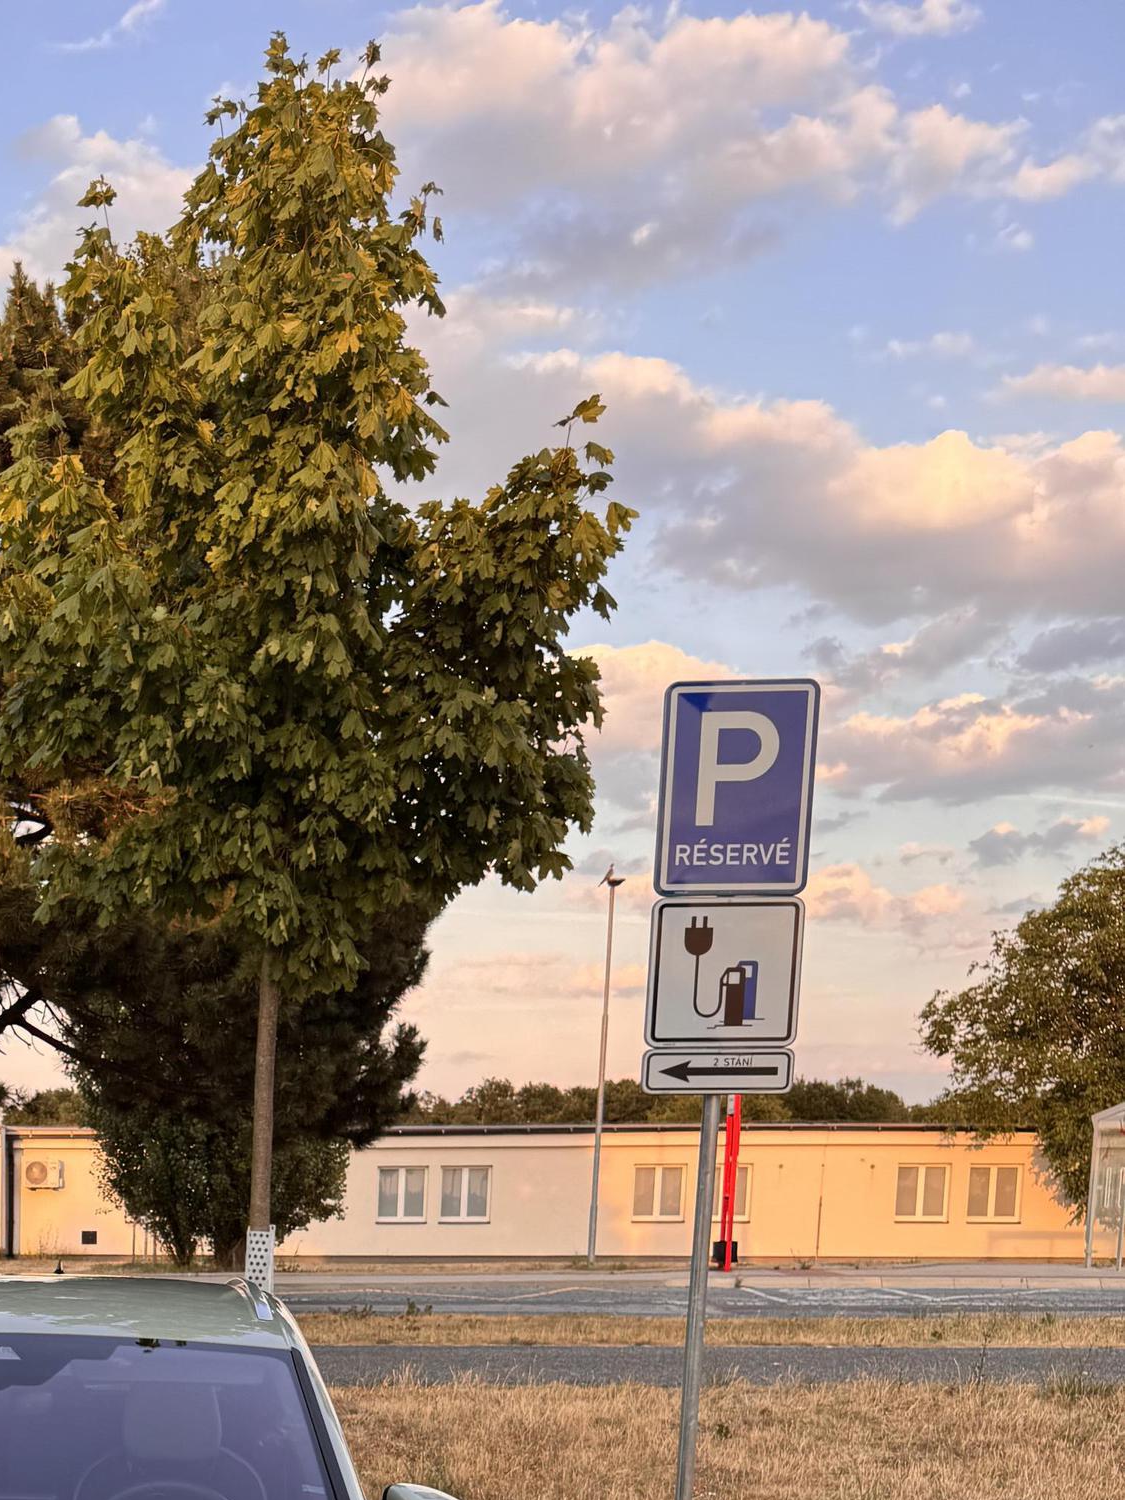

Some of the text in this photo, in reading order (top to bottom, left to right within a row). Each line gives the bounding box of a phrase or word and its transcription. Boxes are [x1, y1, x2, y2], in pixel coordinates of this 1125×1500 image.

[695, 711, 780, 826] P
[675, 838, 791, 866] RÉSERVÉ
[713, 1055, 753, 1067] 2 STÁNÍ
